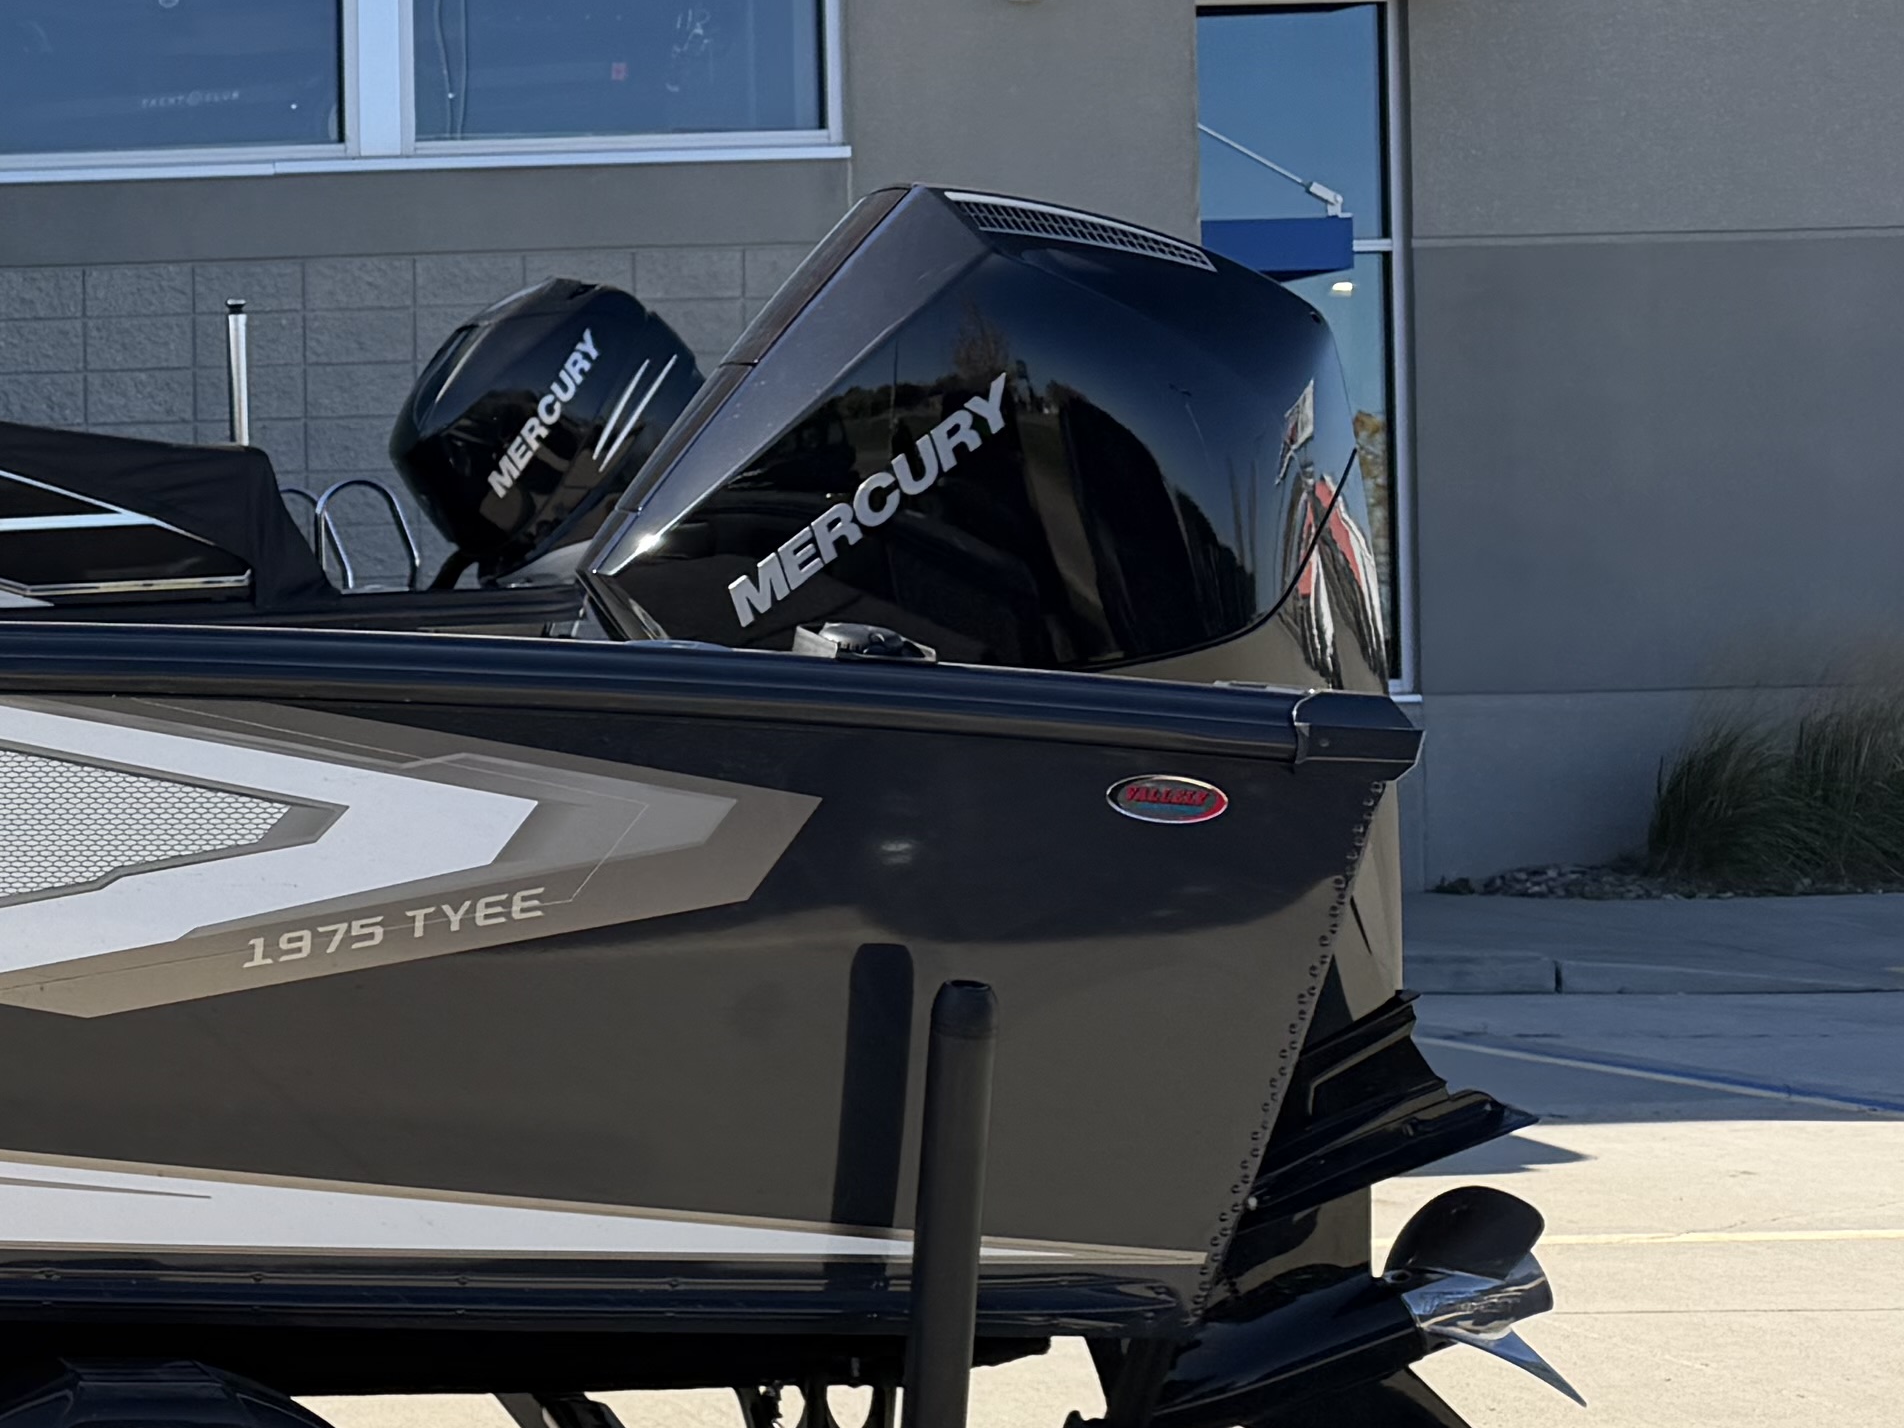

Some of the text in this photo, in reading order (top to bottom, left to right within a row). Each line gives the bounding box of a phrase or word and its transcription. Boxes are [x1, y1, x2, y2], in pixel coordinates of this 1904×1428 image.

[487, 327, 601, 500] MERCURY
[727, 371, 1007, 628] MERCURY
[1125, 784, 1210, 807] VALLELY
[242, 886, 546, 968] 1975 TYEE
